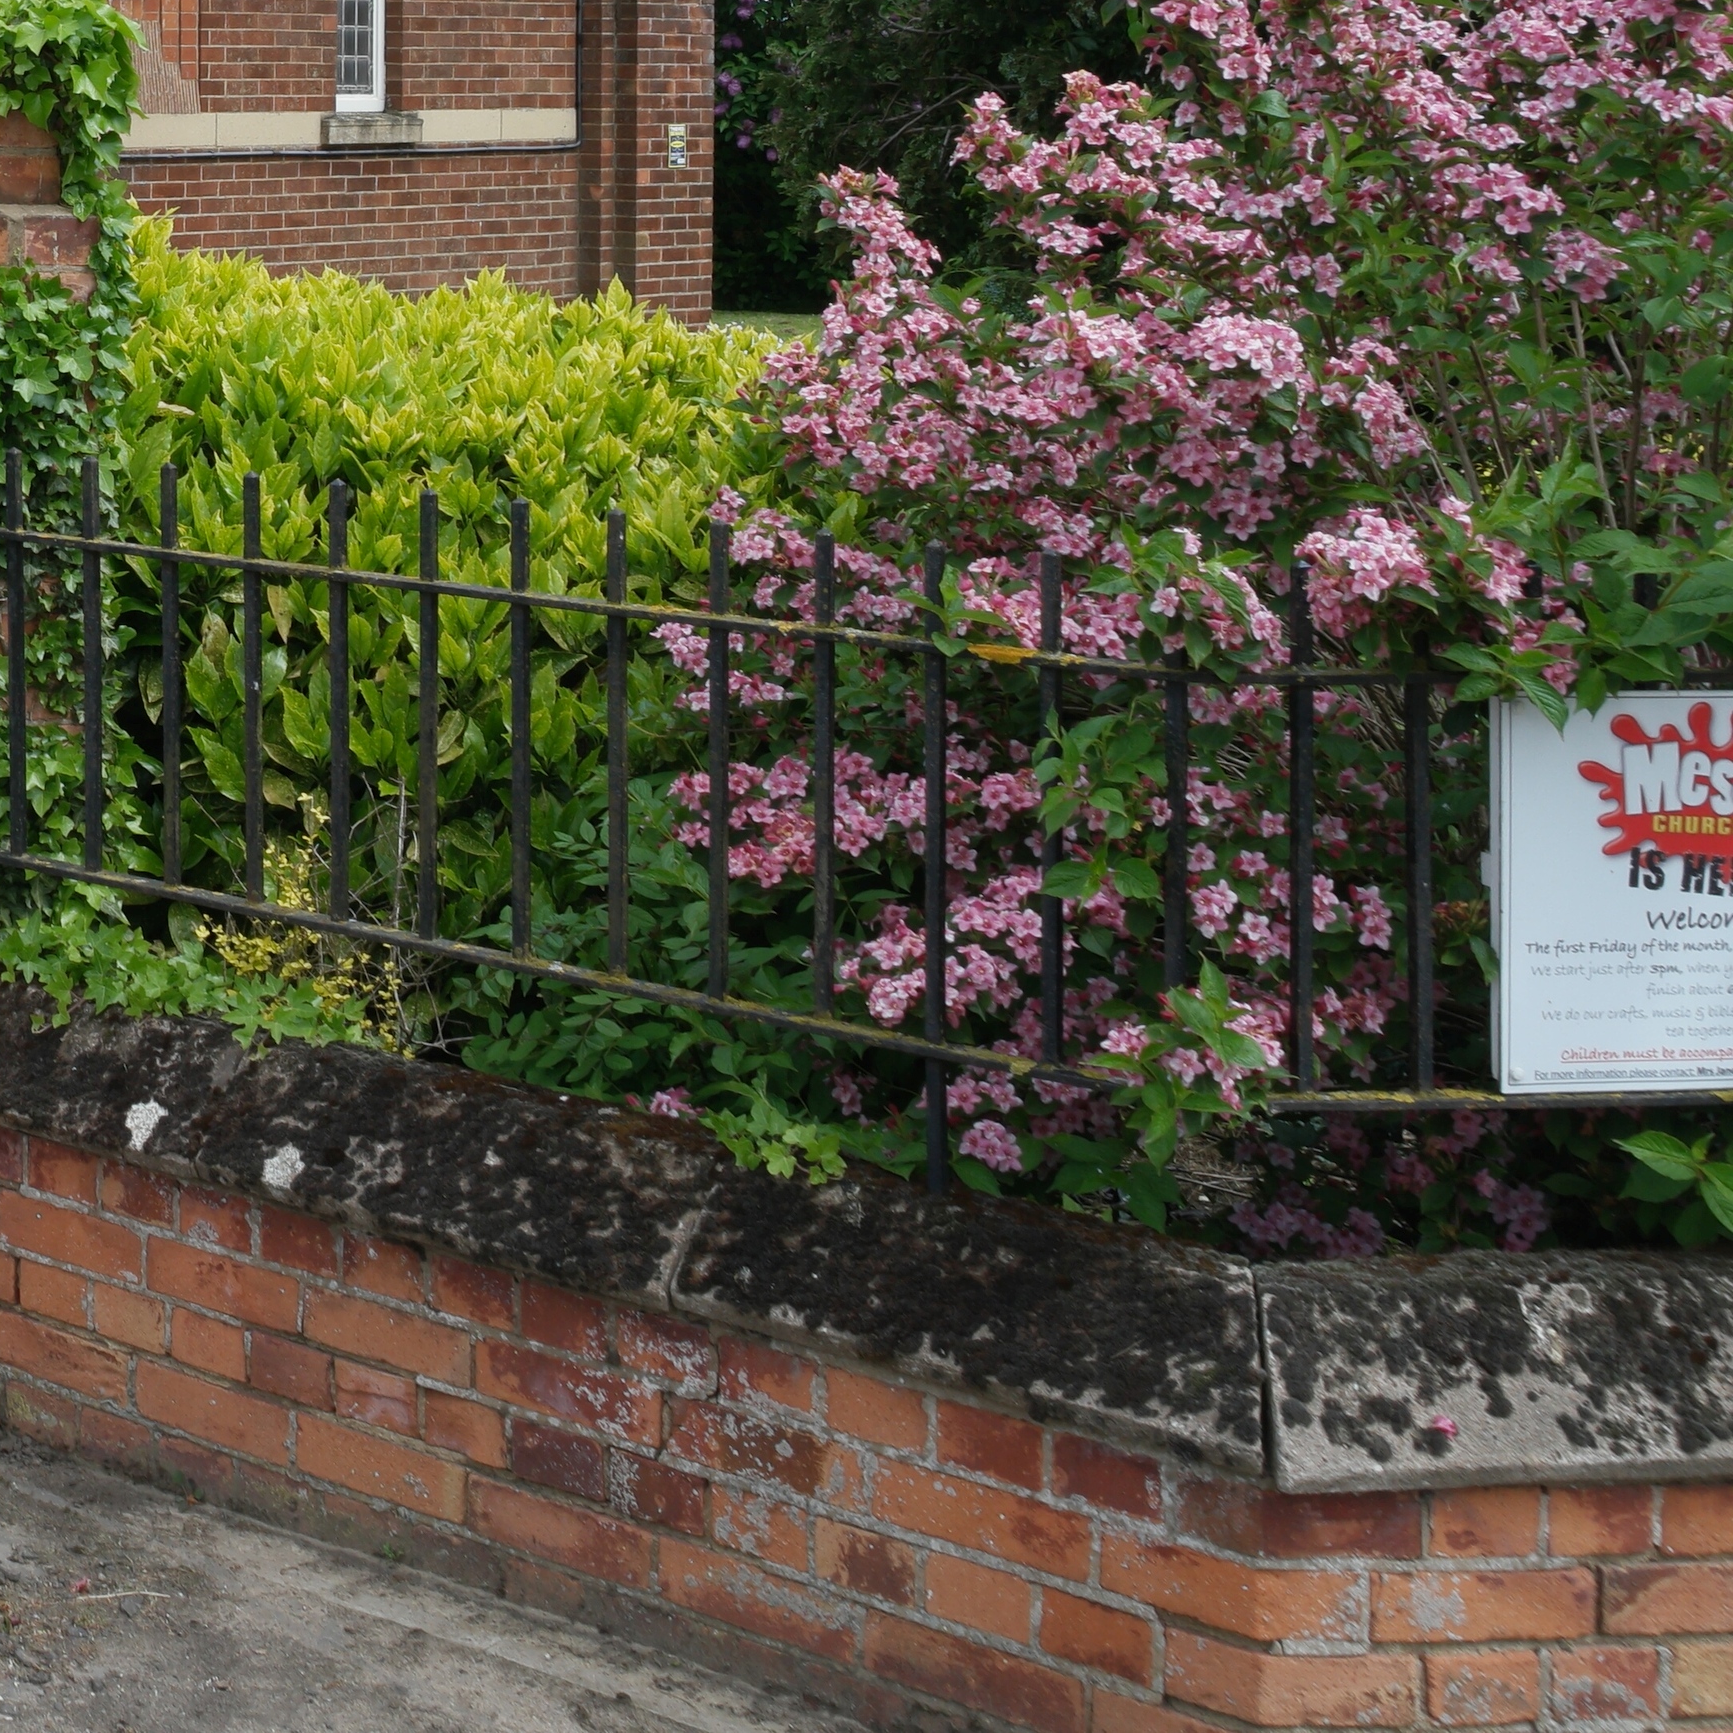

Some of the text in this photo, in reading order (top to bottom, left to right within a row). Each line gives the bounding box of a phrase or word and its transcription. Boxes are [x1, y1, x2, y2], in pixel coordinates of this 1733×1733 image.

[1628, 847, 1733, 897] IS HE
[1525, 940, 1550, 954] The
[1553, 939, 1586, 958] first
[1589, 938, 1637, 959] Friday
[1641, 938, 1657, 956] of
[1658, 939, 1679, 953] the
[1531, 965, 1551, 976] We
[1554, 964, 1584, 976] start
[1586, 961, 1614, 981] just
[1616, 961, 1645, 978] after
[1686, 961, 1720, 973] when
[1646, 982, 1685, 999] finish
[1688, 982, 1724, 995] about
[1541, 1009, 1562, 1021] We
[1564, 1007, 1581, 1020] do
[1583, 1010, 1604, 1021] our
[1652, 1006, 1691, 1018] music
[1665, 1026, 1684, 1037] tea
[1560, 1047, 1619, 1061] Children
[1623, 1048, 1660, 1059] must
[1662, 1046, 1675, 1058] be
[1534, 1069, 1549, 1081] For
[1550, 1070, 1574, 1080] more
[1576, 1067, 1627, 1080] information
[1629, 1067, 1659, 1081] please
